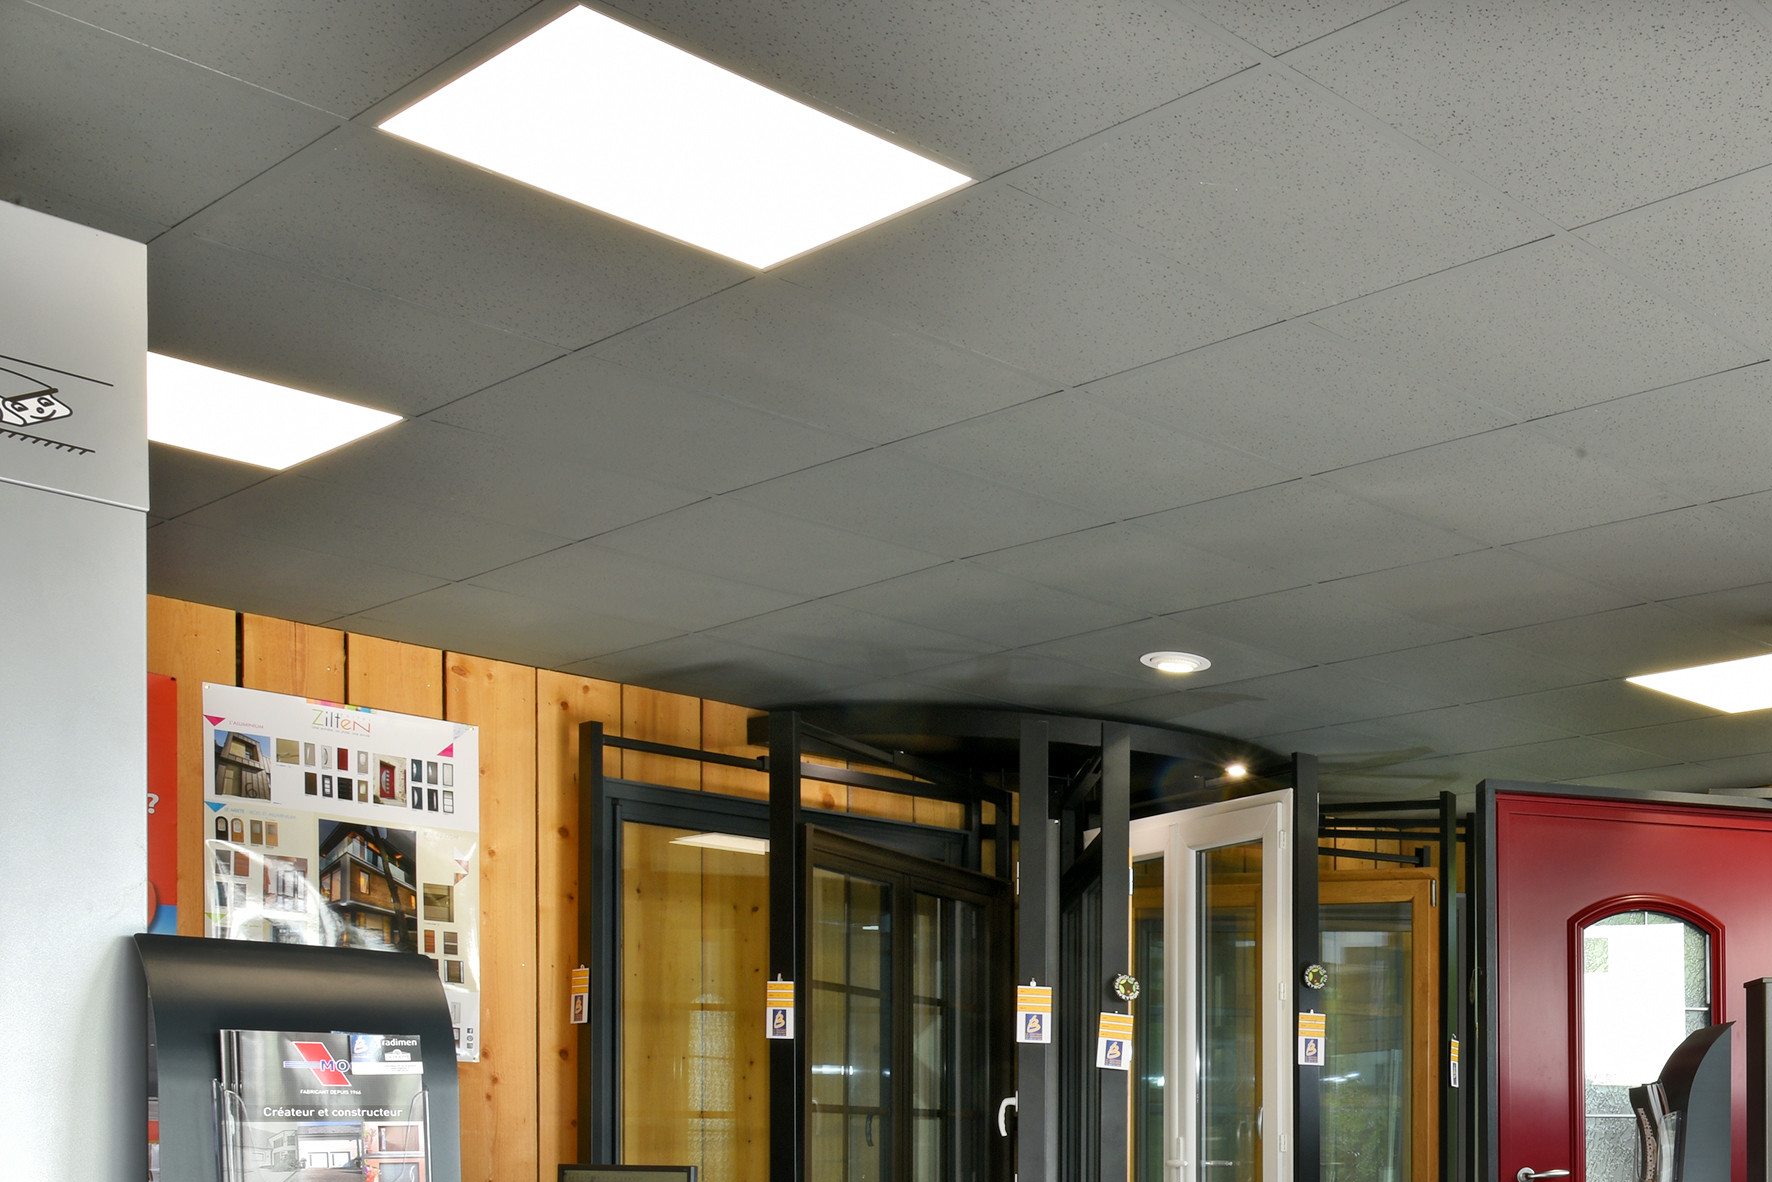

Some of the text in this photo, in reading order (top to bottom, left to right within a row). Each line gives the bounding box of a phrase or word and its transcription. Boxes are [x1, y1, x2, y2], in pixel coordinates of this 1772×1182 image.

[263, 1106, 403, 1118] Créateur et constructeur
